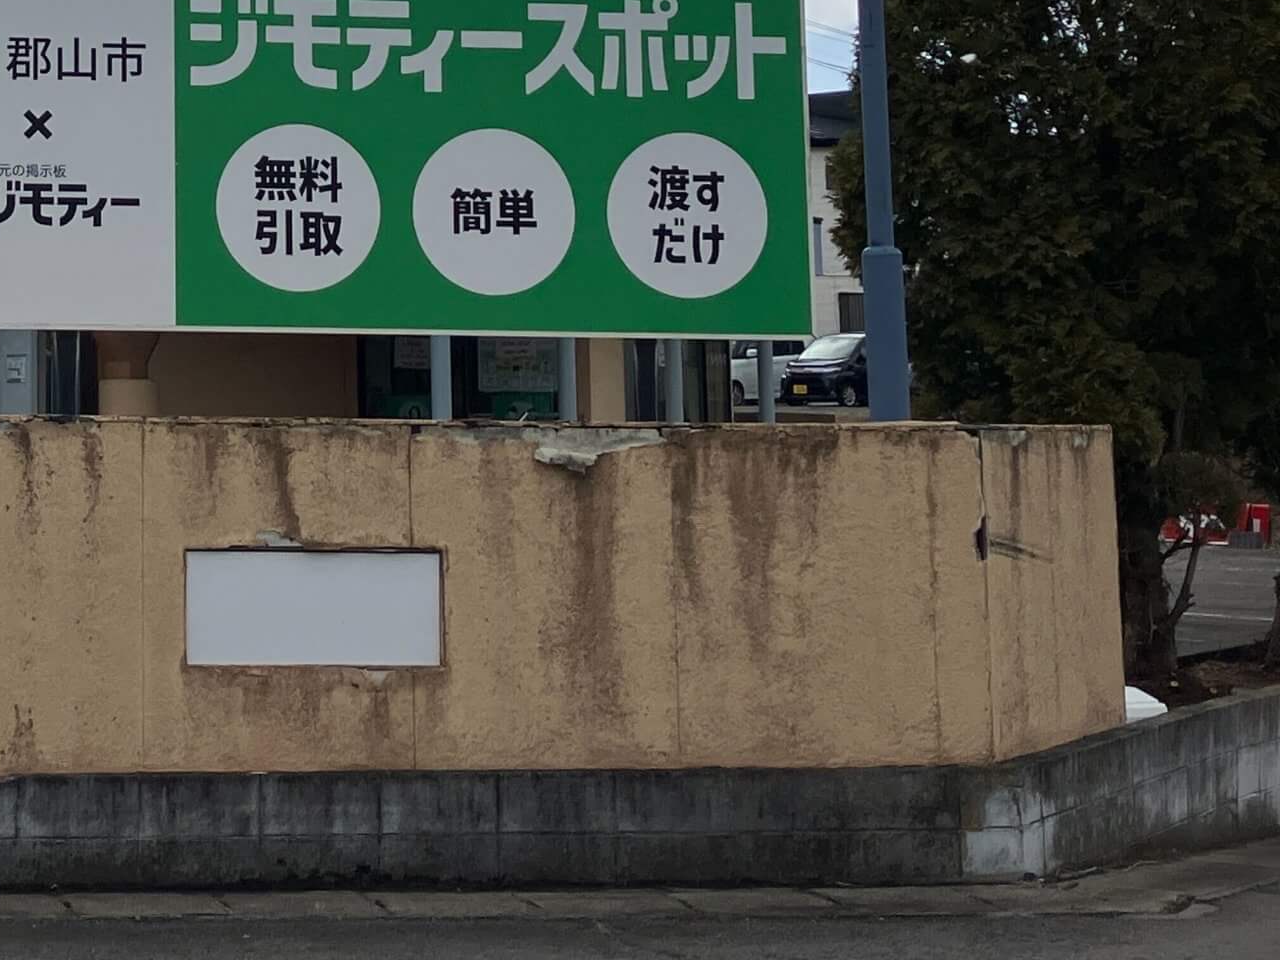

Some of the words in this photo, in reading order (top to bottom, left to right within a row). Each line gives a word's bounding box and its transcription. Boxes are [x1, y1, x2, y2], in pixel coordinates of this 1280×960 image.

[6, 36, 147, 83] 郡山市
[254, 155, 343, 204] 無料
[648, 165, 725, 212] 渡す
[255, 209, 343, 257] 引取
[450, 187, 537, 235] 簡単
[652, 217, 725, 265] だけ
